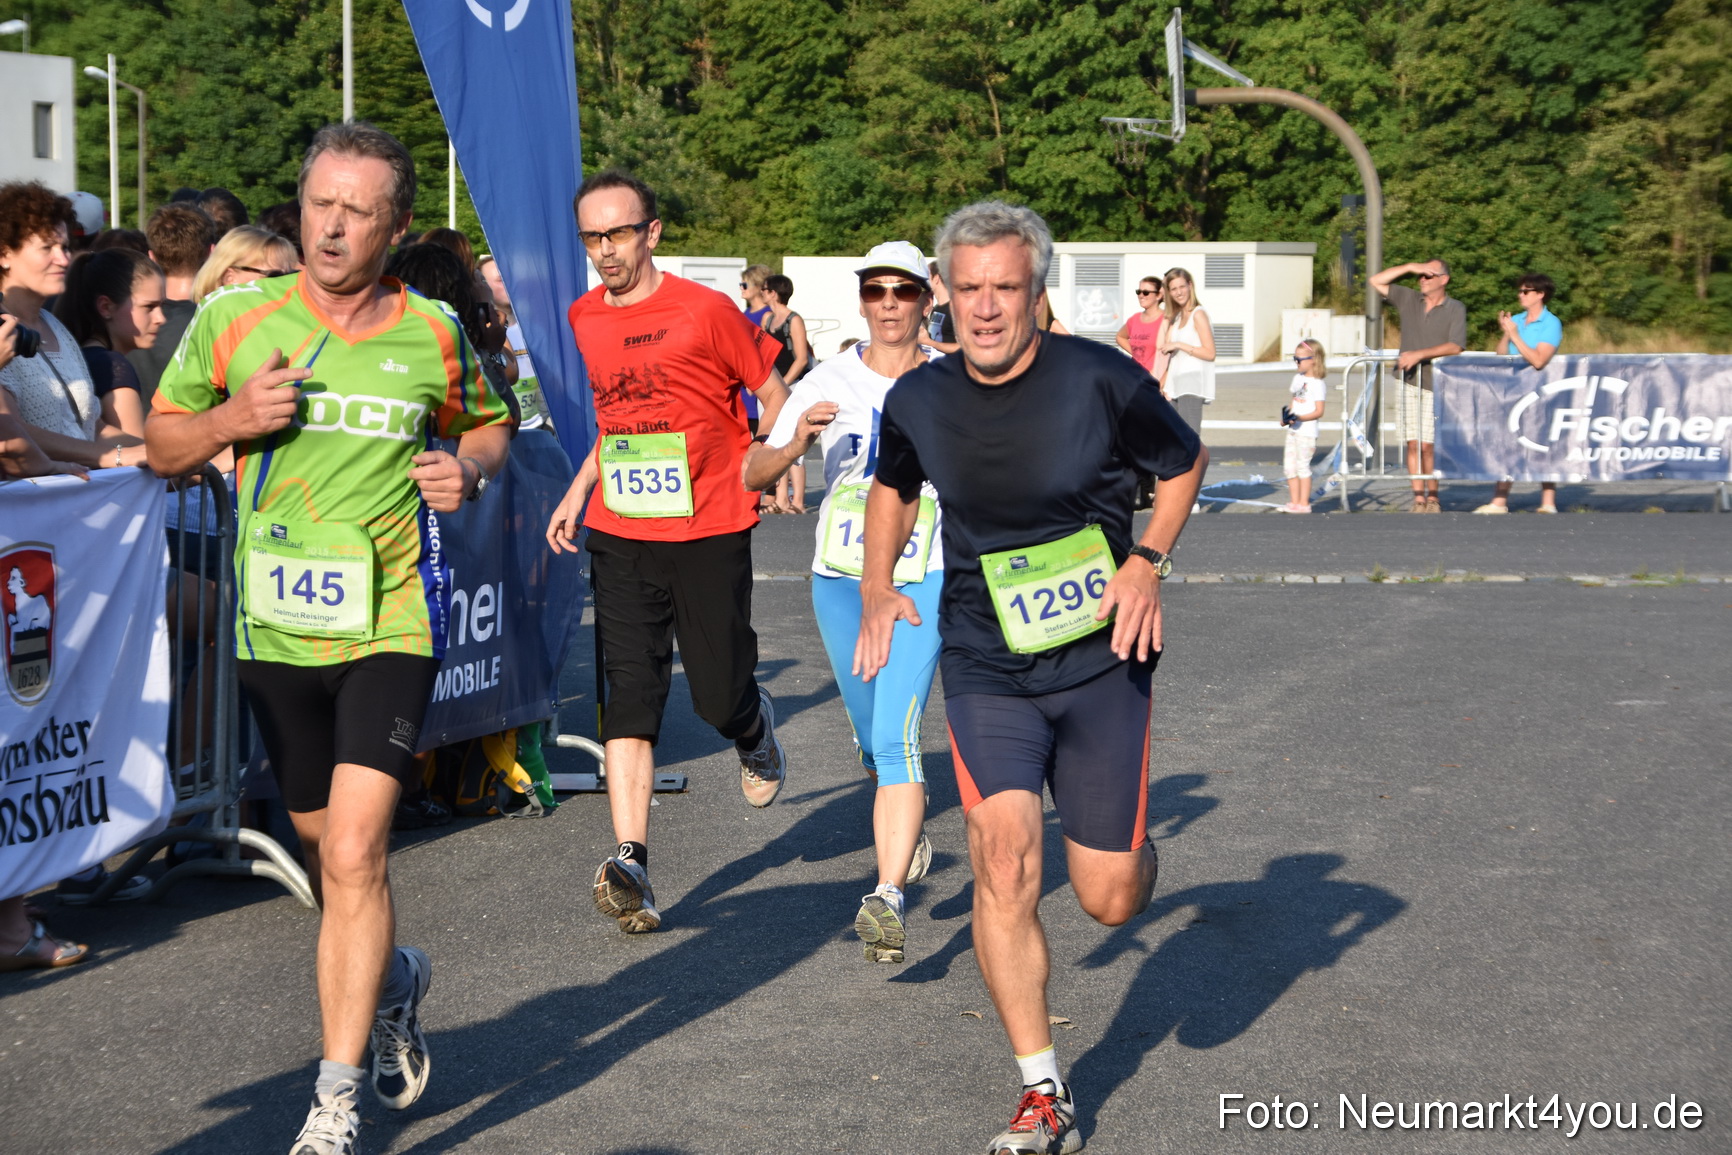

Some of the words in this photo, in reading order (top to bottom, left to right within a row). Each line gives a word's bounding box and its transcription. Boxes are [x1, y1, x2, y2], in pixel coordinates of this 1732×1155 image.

[624, 333, 652, 346] swn
[299, 392, 426, 440] OCK
[1549, 406, 1732, 443] Fischer
[605, 425, 633, 435] Alles
[636, 420, 670, 433] läuft
[1566, 446, 1722, 462] AUTOMOBILE
[610, 467, 682, 494] 1535
[263, 535, 304, 549] firmenlauf
[1005, 562, 1047, 577] firmenlauf
[270, 565, 345, 606] 145
[1009, 568, 1108, 625] 1296
[273, 608, 300, 618] Helmut
[300, 611, 338, 623] Reisinger
[1044, 622, 1068, 633] Stefan
[1068, 613, 1091, 625] Lukas
[17, 665, 41, 689] 1628
[432, 655, 501, 702] MOBILE
